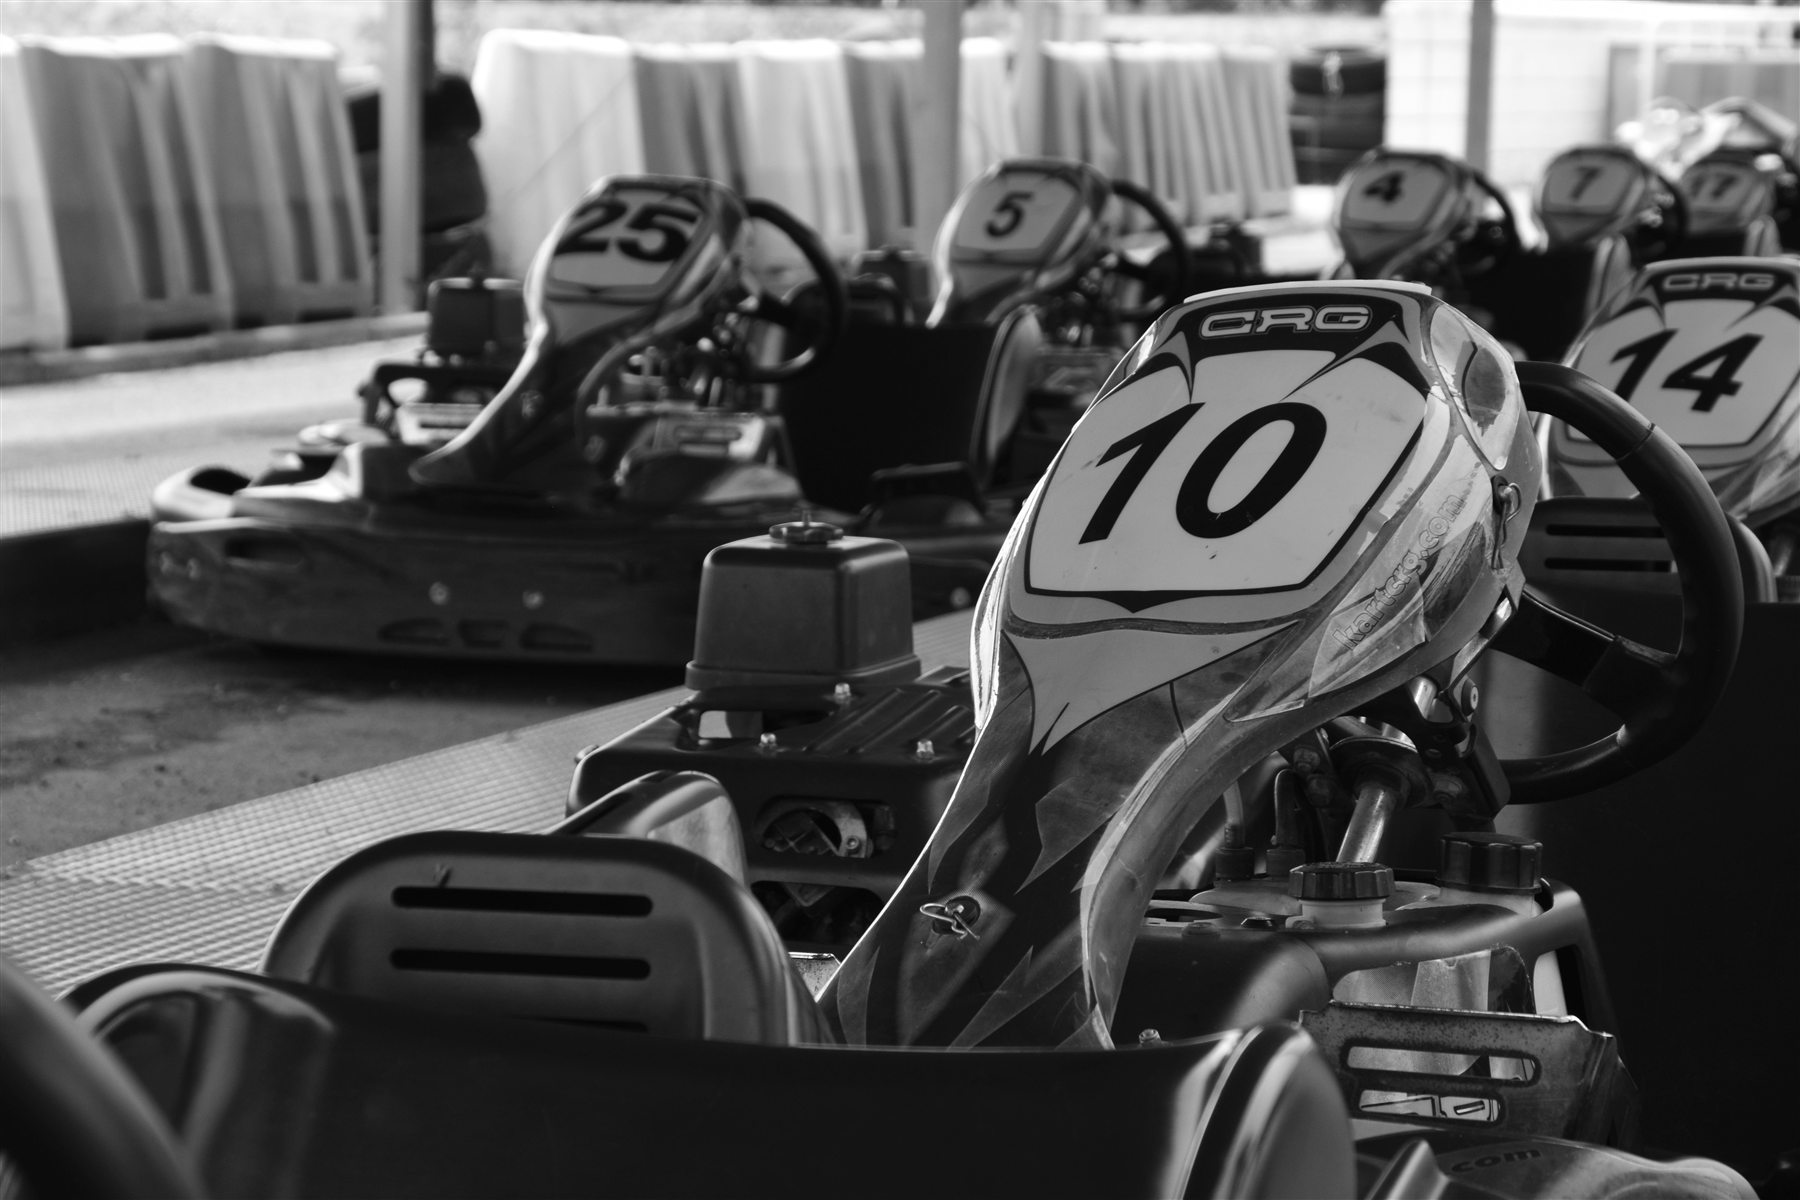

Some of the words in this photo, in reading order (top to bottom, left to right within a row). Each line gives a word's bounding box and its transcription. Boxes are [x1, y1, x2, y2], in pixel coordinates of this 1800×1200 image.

[986, 190, 1034, 238] 5
[1363, 169, 1405, 204] 4
[553, 201, 698, 263] 25
[1662, 272, 1777, 291] CRG
[1200, 305, 1372, 338] CRG
[1610, 328, 1764, 413] 14
[1078, 402, 1327, 544] 10
[1332, 494, 1466, 650] kartcrg.com
